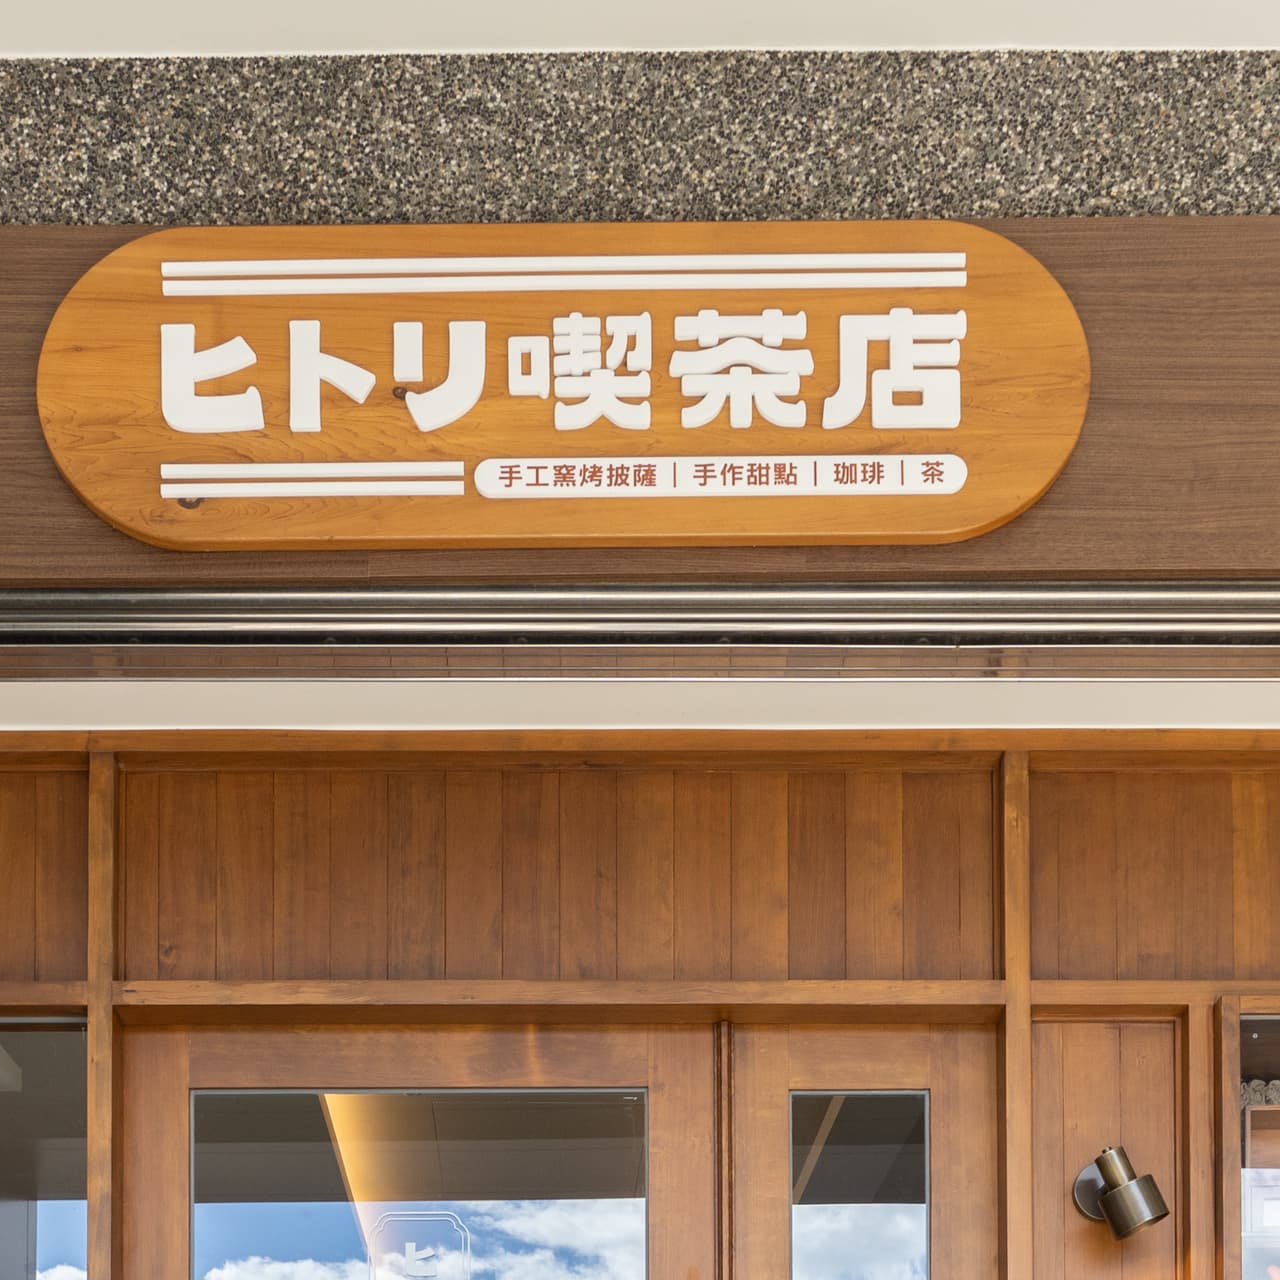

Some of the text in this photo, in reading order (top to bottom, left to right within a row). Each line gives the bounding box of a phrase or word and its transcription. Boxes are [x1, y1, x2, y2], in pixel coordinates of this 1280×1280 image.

[160, 307, 967, 434] ヒトリ喫茶店
[498, 460, 945, 488] 手工窯烤披薩 手作甜點 珈琲 茶
